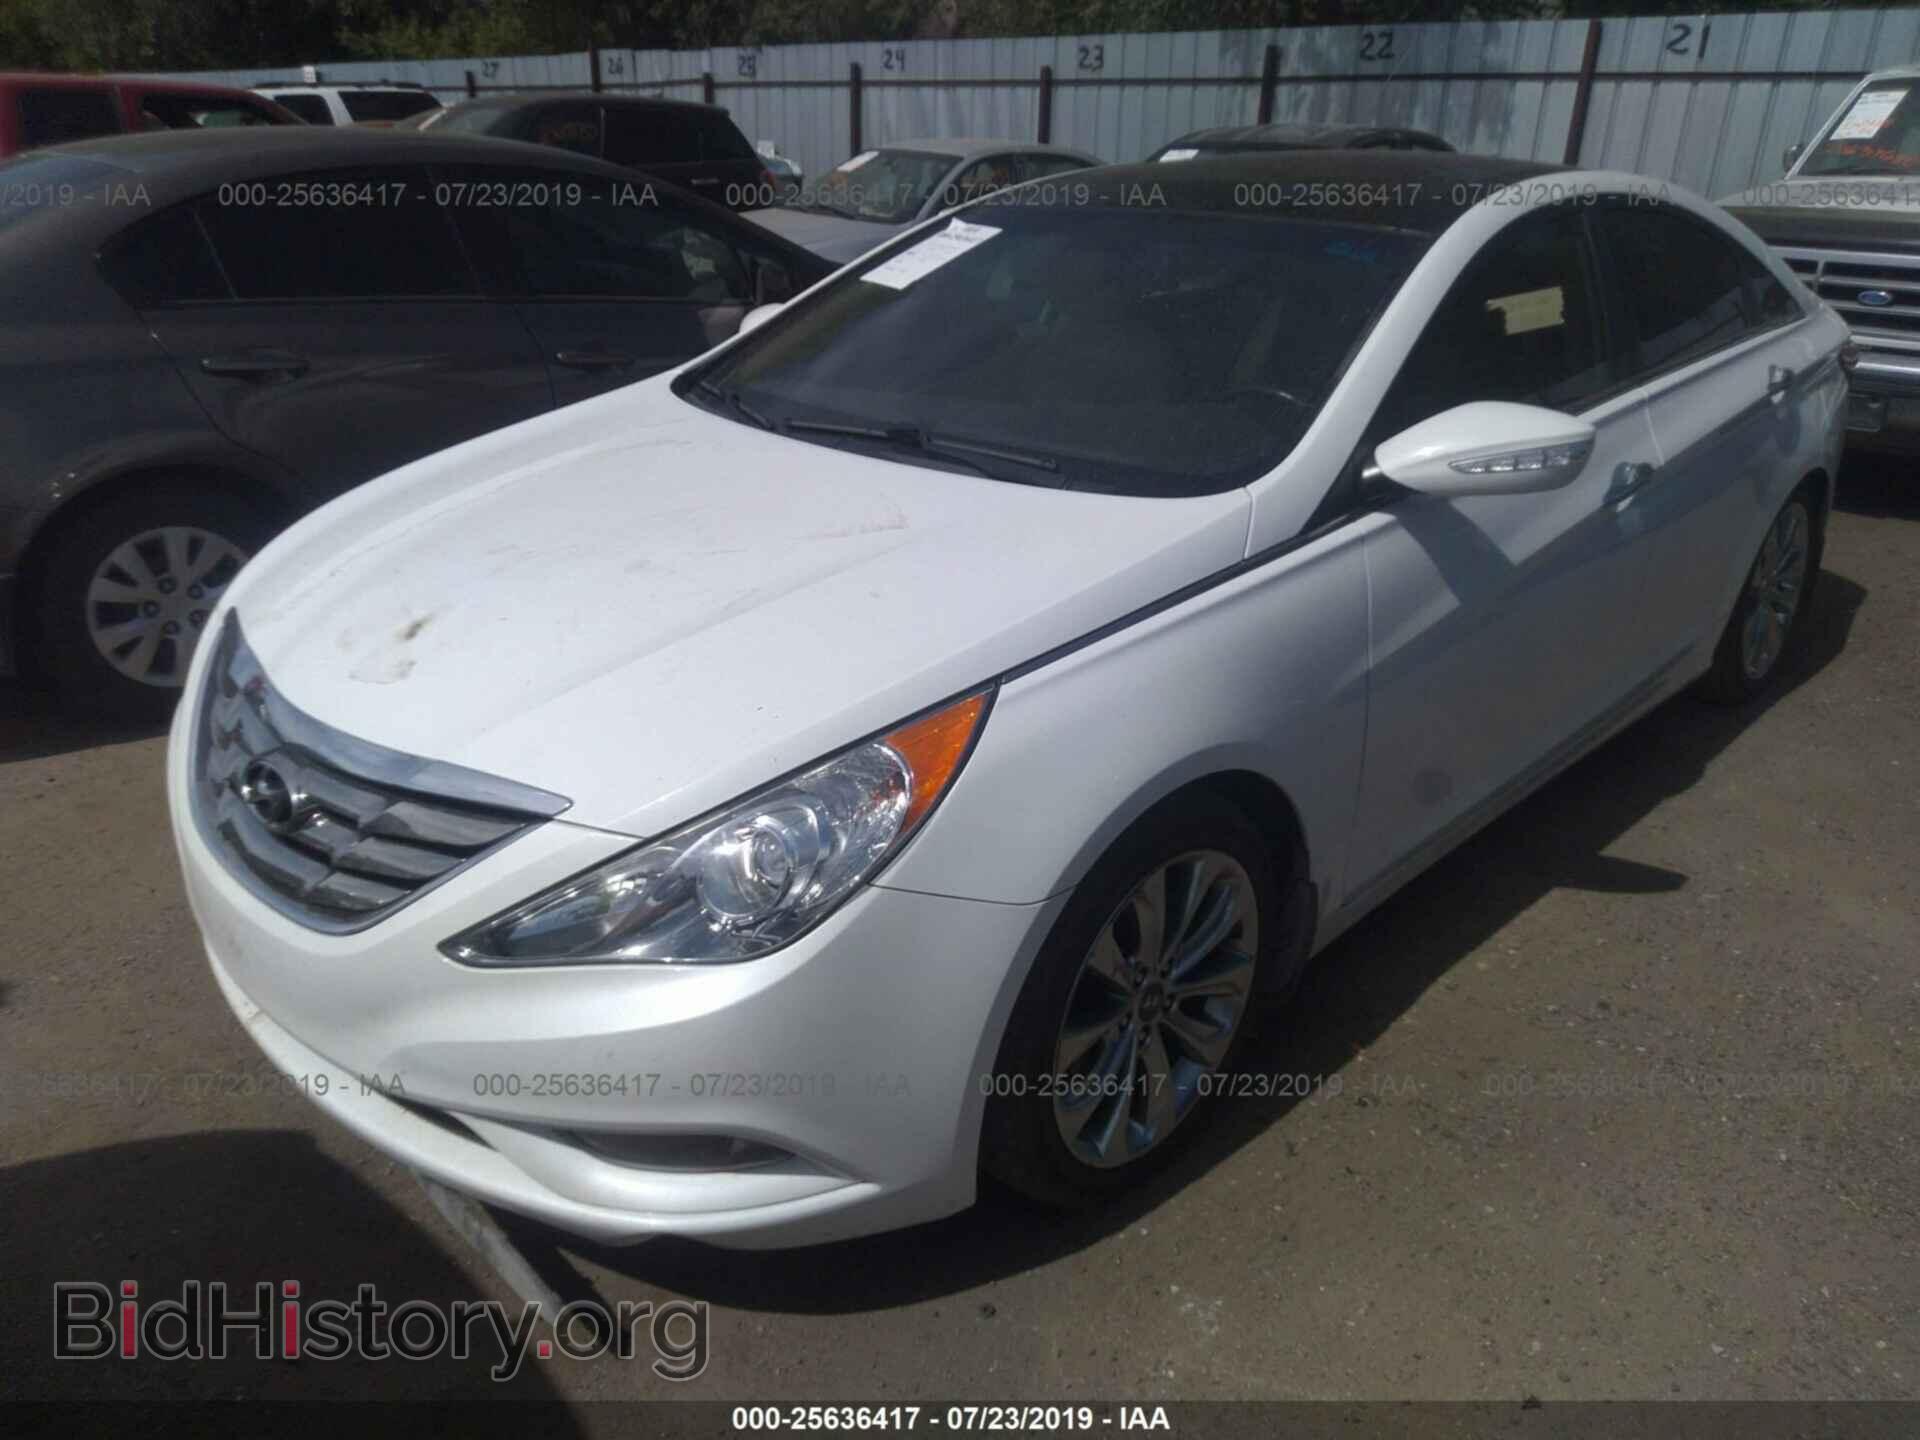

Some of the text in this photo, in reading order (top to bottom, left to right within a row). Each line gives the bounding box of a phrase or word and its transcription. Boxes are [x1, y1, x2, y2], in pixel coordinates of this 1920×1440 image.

[1360, 32, 1395, 60] 22
[1665, 23, 1710, 59] 21
[882, 50, 905, 72] 24
[1077, 45, 1104, 71] 23
